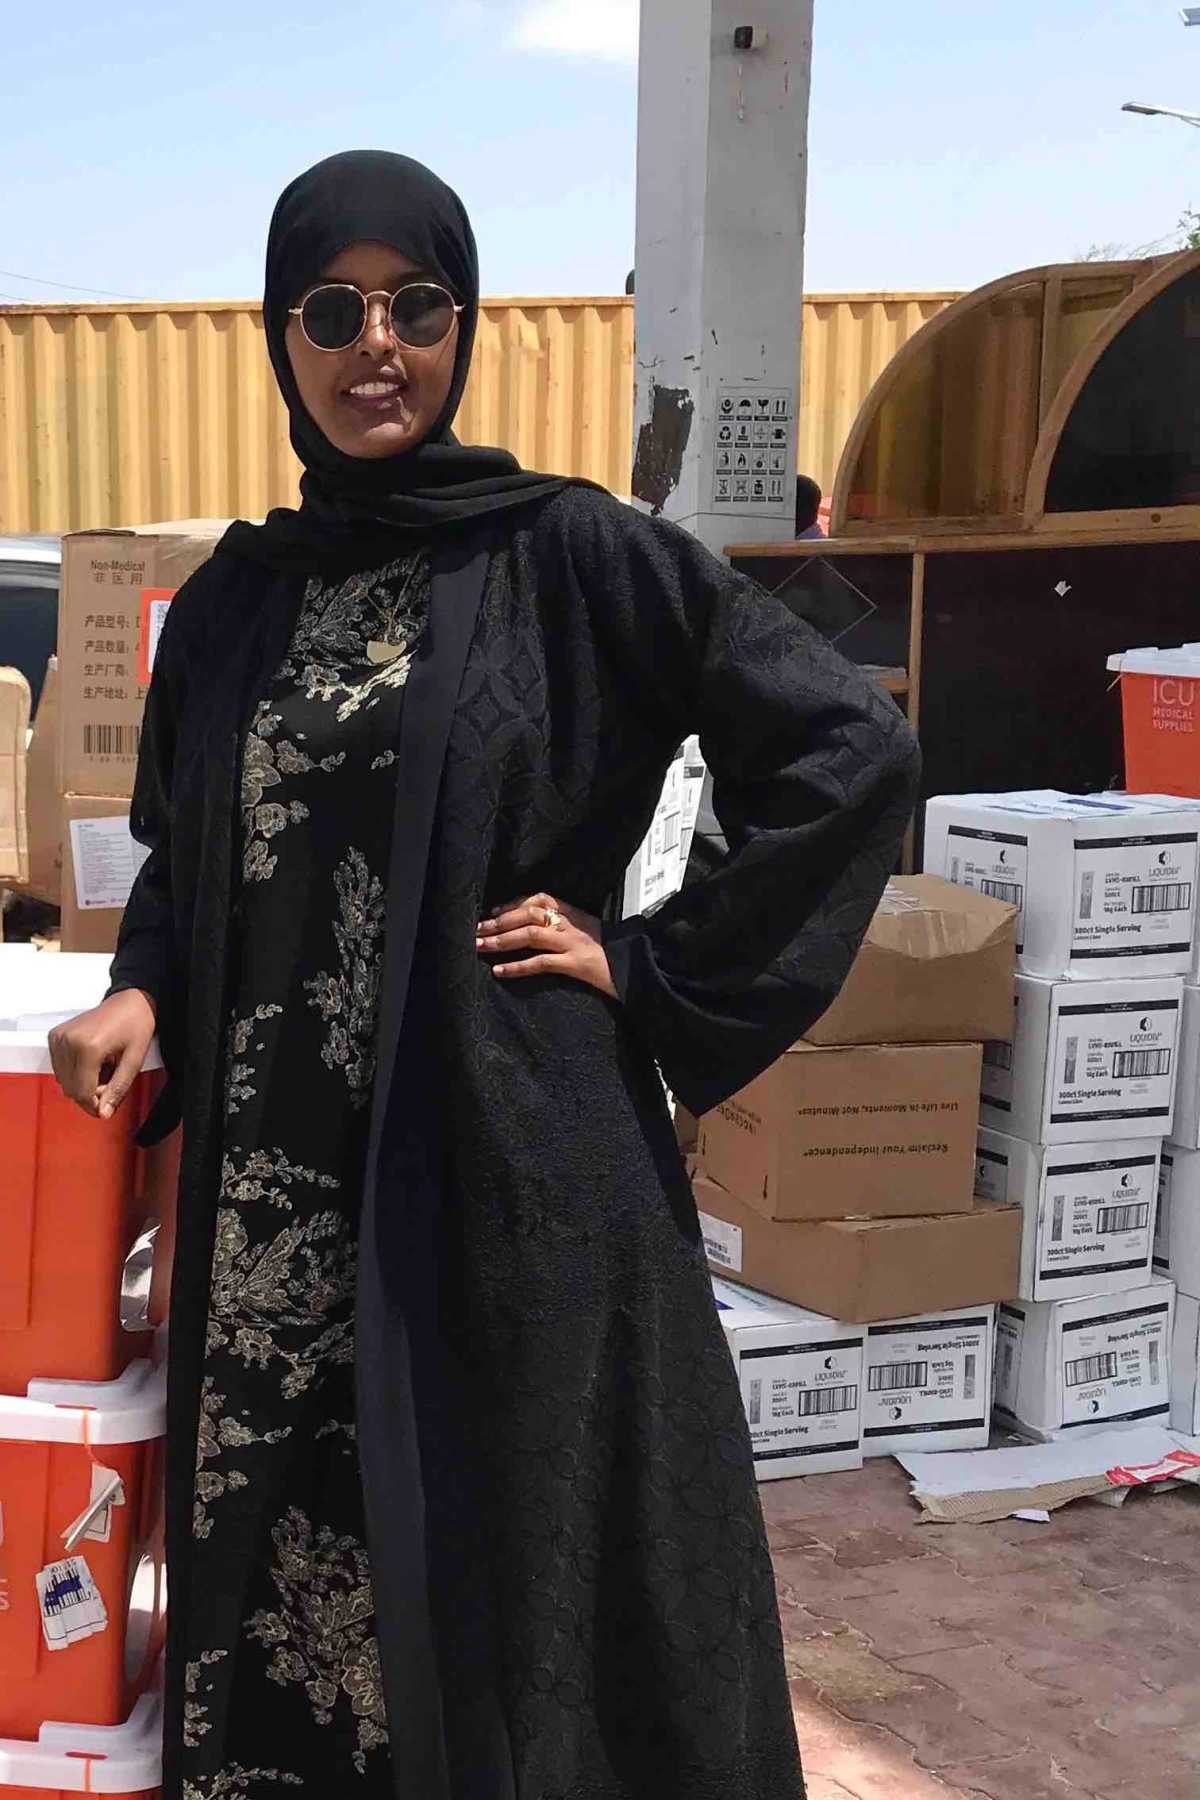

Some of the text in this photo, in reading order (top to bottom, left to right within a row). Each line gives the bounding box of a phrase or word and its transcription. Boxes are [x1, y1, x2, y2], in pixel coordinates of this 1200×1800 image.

[91, 560, 145, 572] Non-Medical
[1152, 679, 1195, 706] ICU
[1116, 923, 1142, 934] Serving
[1078, 1089, 1098, 1100] Single
[1098, 1087, 1122, 1098] Serving
[941, 1103, 959, 1112] Live
[882, 1144, 905, 1155] Your
[1083, 1243, 1105, 1253] Serving
[764, 1428, 784, 1438] Single
[784, 1426, 809, 1436] Serving
